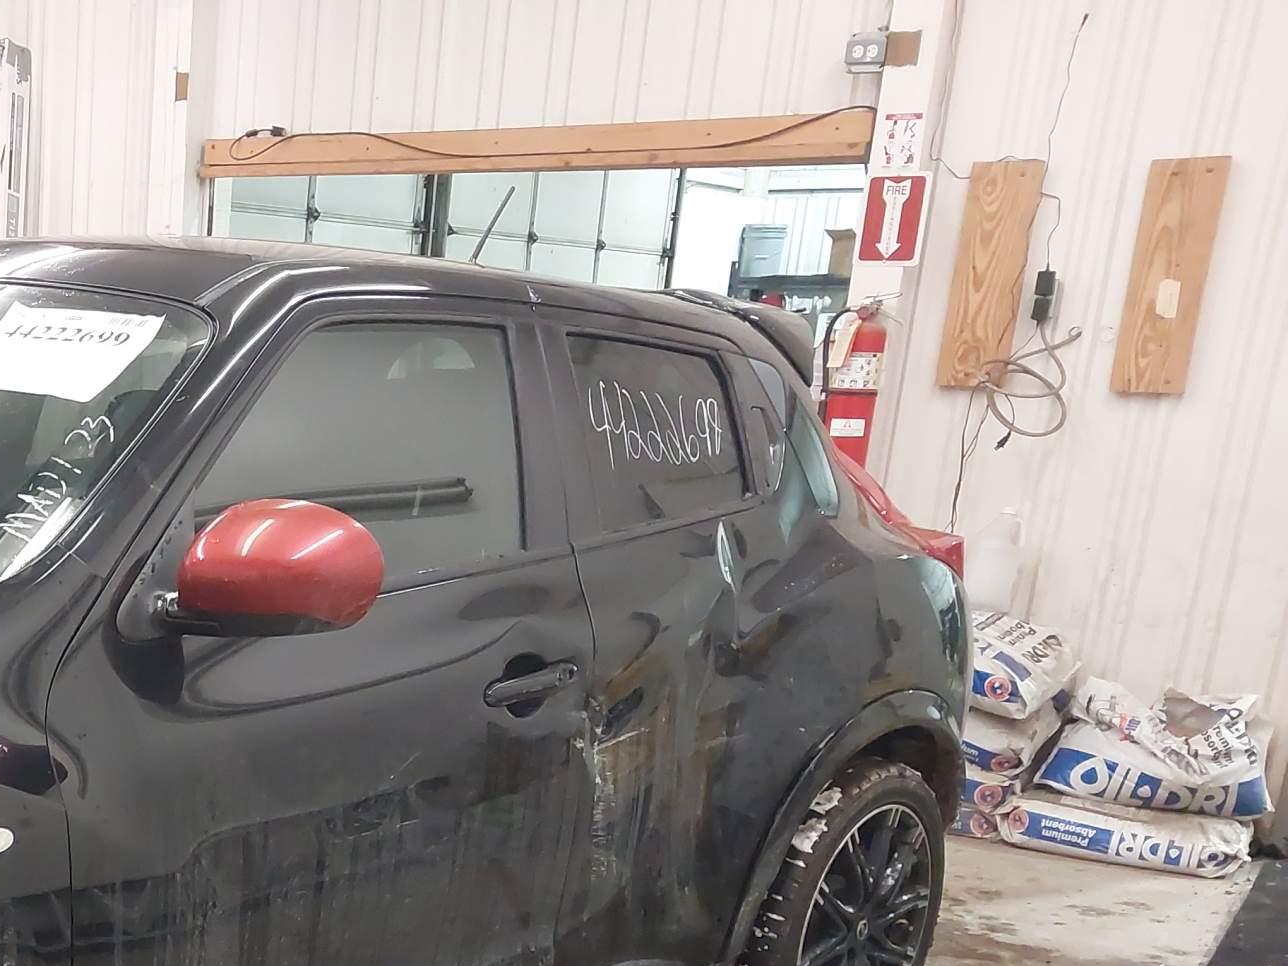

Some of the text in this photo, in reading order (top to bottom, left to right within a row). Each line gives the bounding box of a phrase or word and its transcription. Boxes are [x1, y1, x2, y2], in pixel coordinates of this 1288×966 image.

[886, 185, 908, 196] FIRE
[5, 325, 131, 347] 44222699
[1040, 818, 1097, 837] Absorbent
[1041, 828, 1090, 847] Premium
